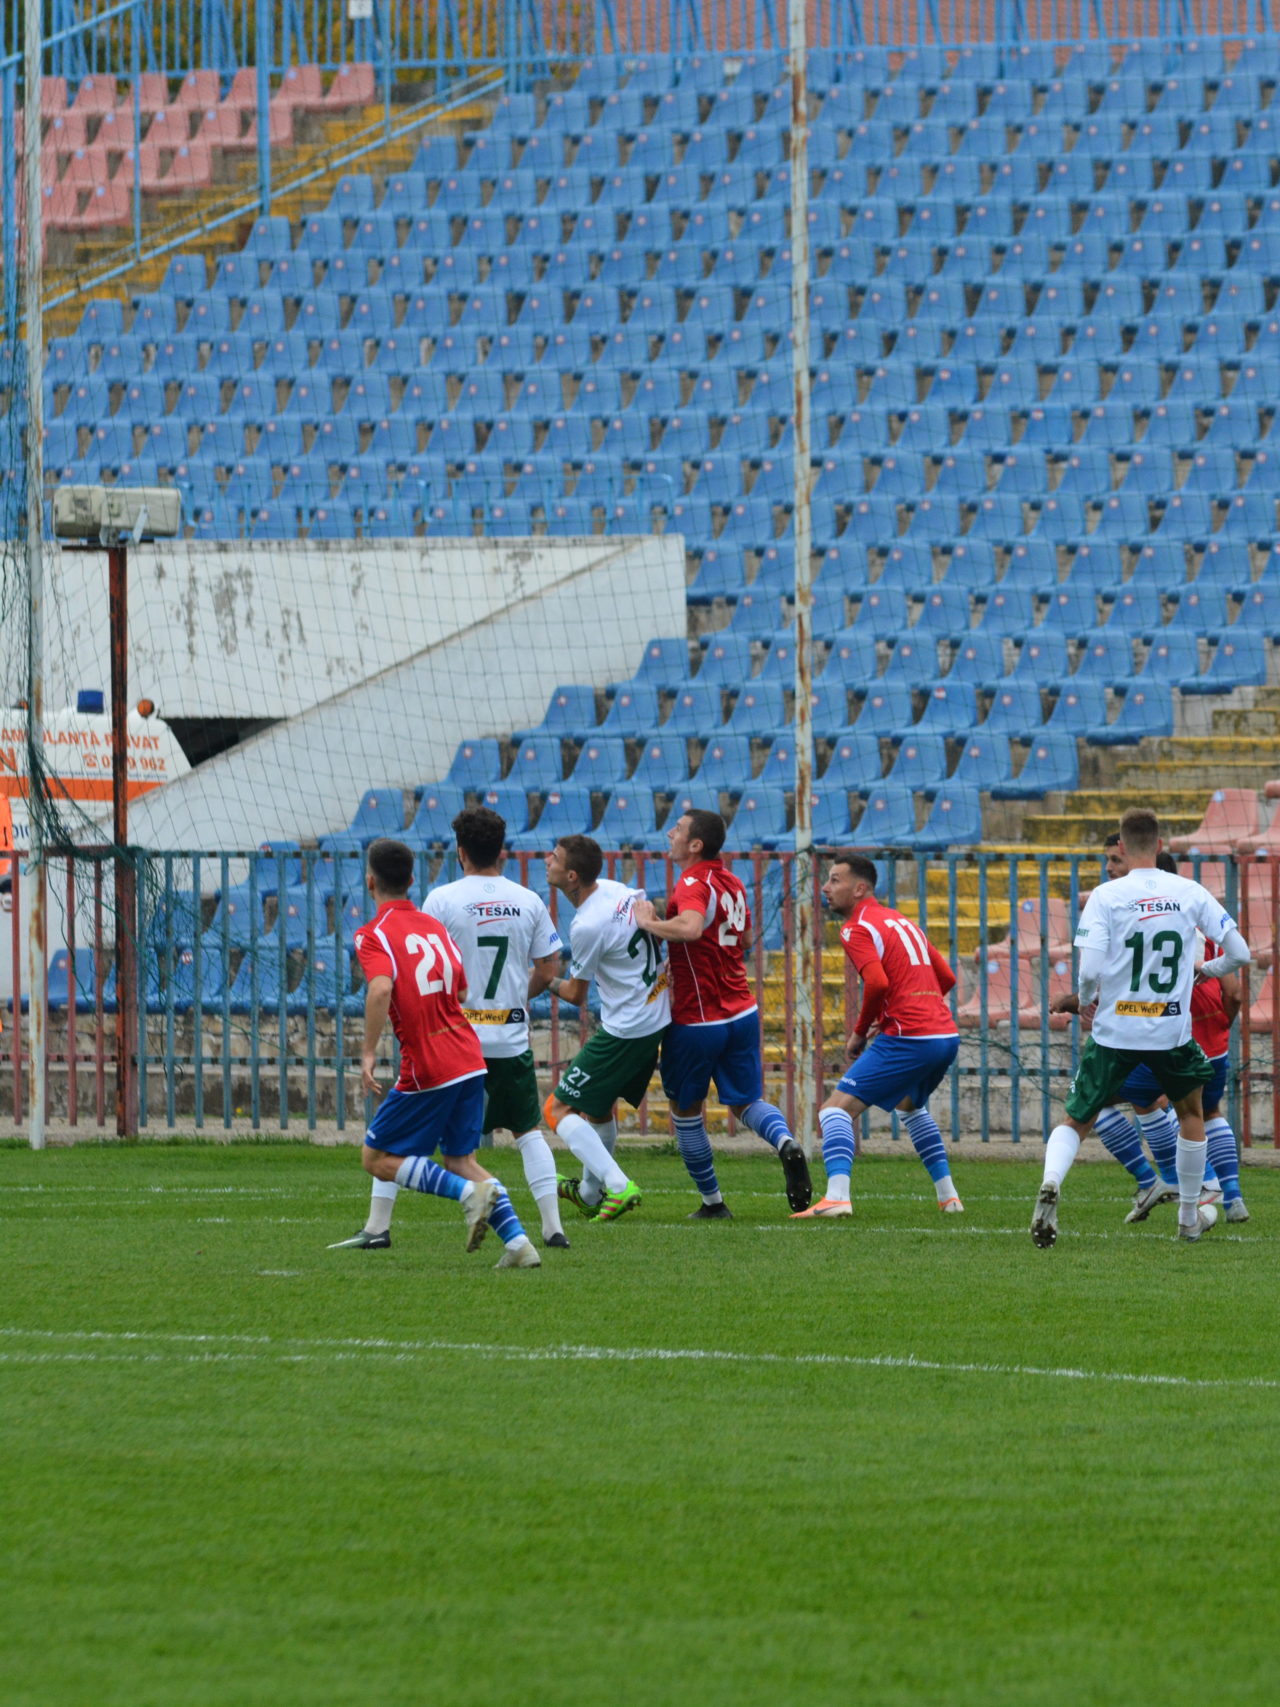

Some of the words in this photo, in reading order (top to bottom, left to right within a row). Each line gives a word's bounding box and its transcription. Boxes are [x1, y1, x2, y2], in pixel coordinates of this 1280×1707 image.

[476, 907, 521, 917] TESAN
[1139, 902, 1181, 913] TESAN
[883, 918, 932, 966] 11
[404, 932, 453, 997] 21
[477, 936, 509, 1000] 7
[1125, 930, 1184, 994] 13
[485, 1012, 505, 1021] West
[1117, 1003, 1138, 1013] OPEL
[1140, 1004, 1159, 1014] West
[567, 1066, 591, 1088] 27
